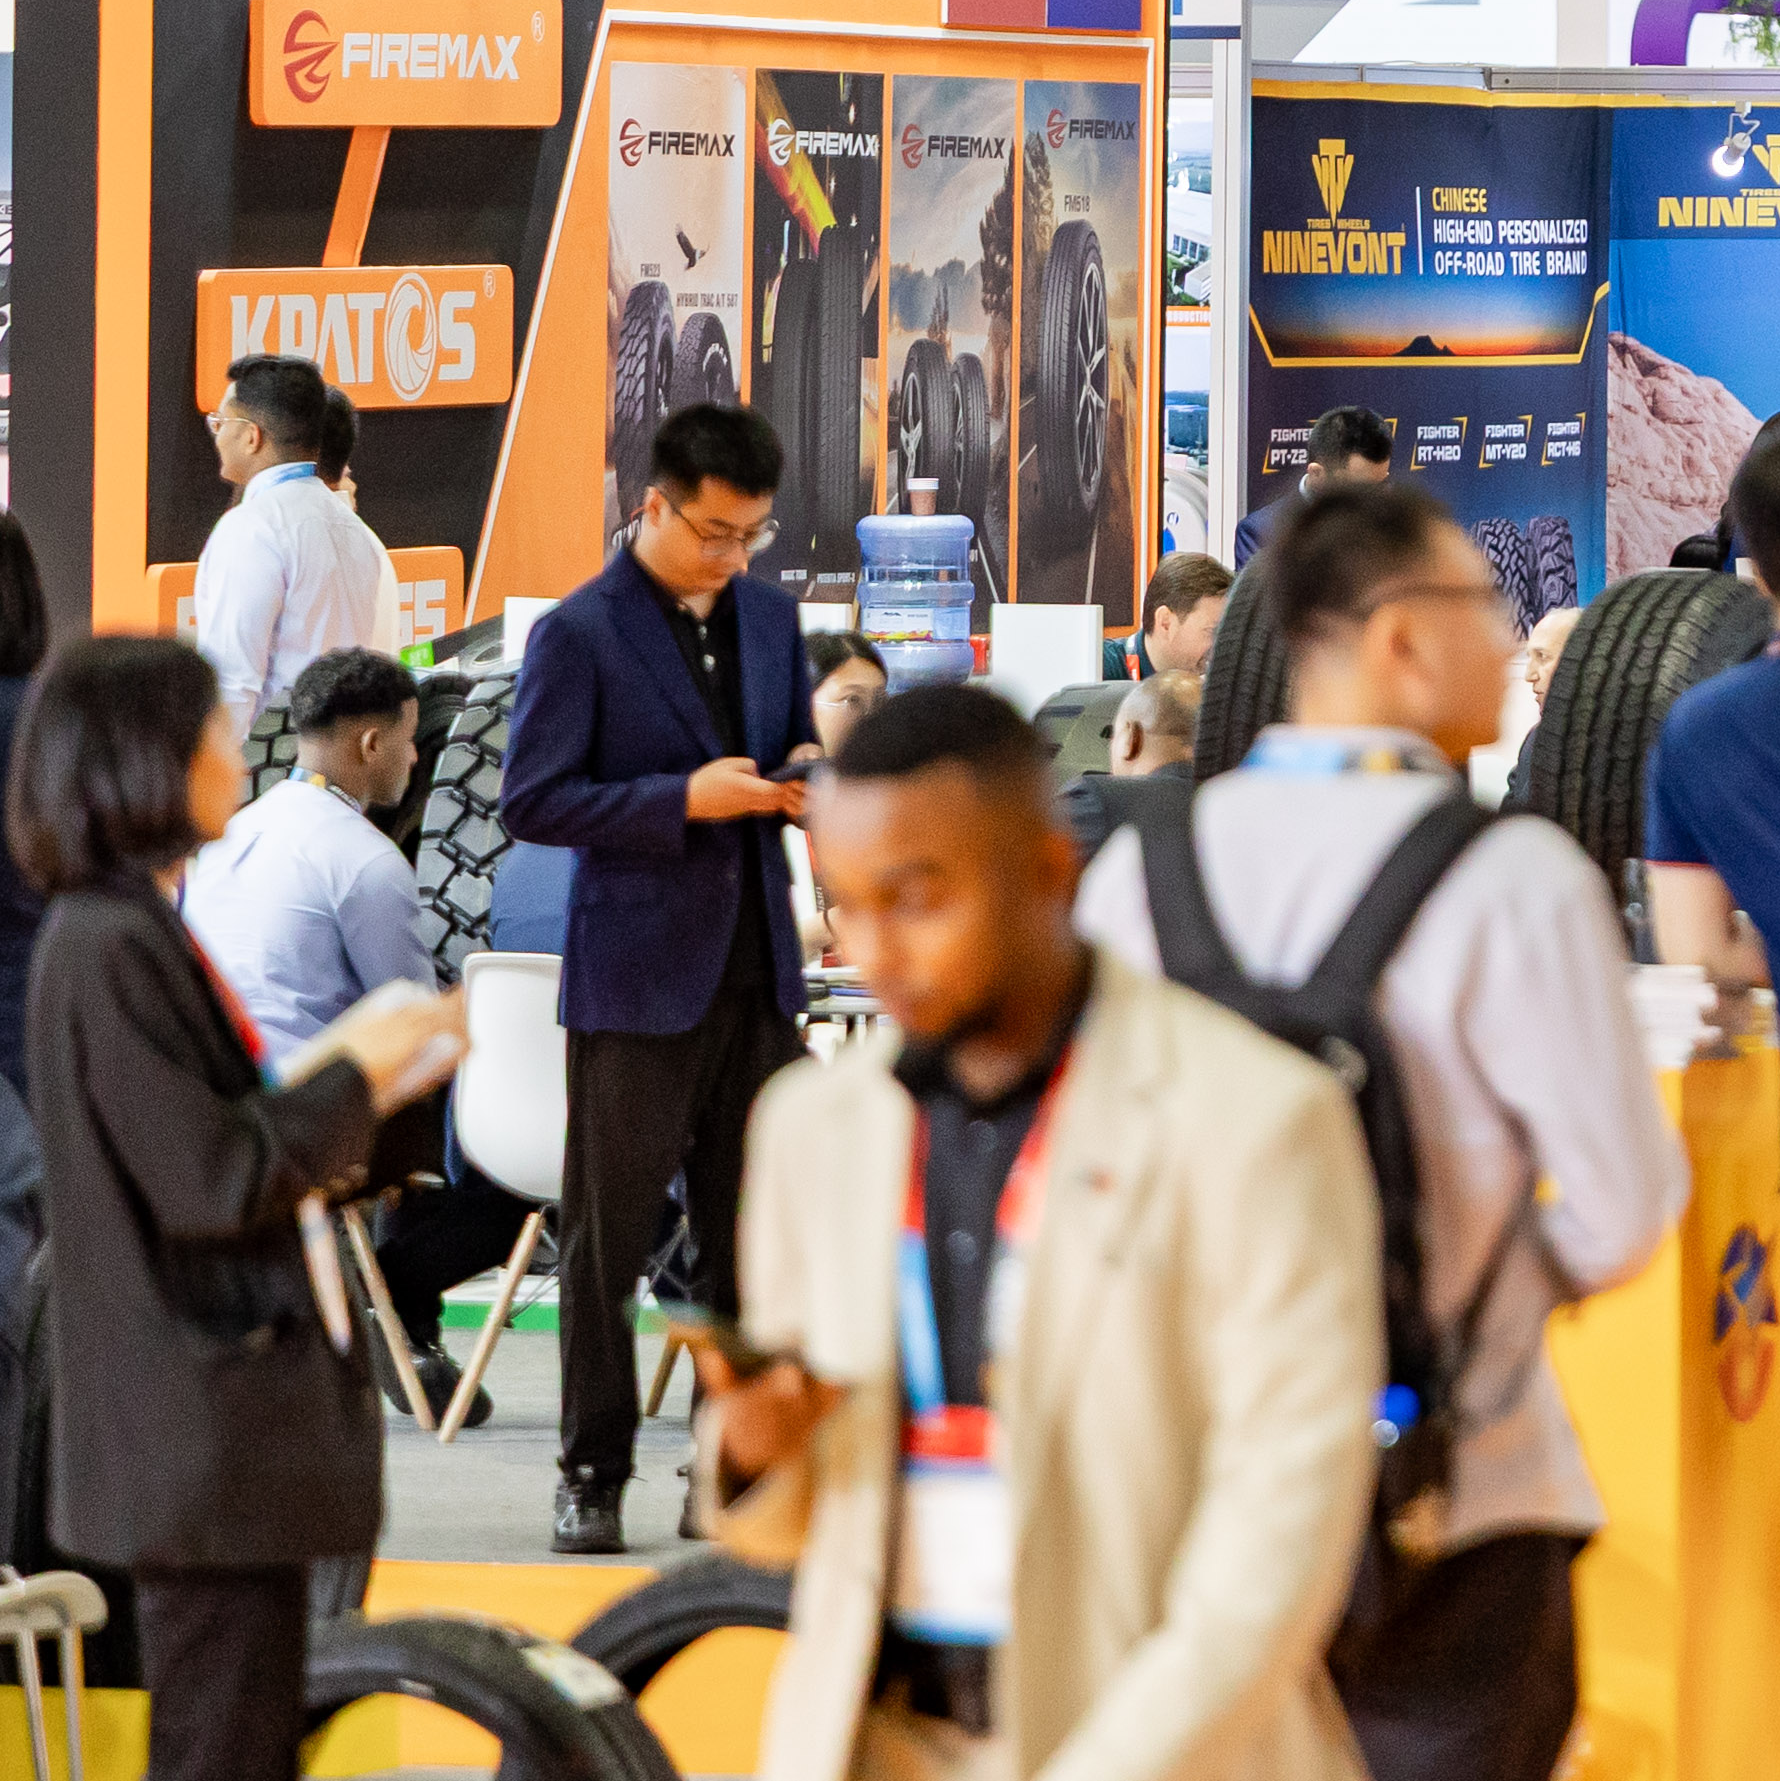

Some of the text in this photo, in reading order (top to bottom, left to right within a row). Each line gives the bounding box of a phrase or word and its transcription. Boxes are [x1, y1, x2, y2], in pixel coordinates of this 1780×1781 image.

[342, 33, 521, 80] FIREMAX
[1069, 118, 1136, 142] FIREMAX
[648, 130, 735, 158] FIREMAX
[796, 130, 877, 158] FIREMAX
[928, 134, 1005, 160] FIREMAX
[1432, 187, 1487, 213] CHINESE
[1433, 218, 1588, 245] HIGH-END PERSONALIZED
[1262, 230, 1406, 276] NINEVONT
[1434, 250, 1588, 276] OFF-ROAD TIRE BRAND
[1270, 428, 1312, 443] FIGHTE
[1417, 425, 1460, 441] FIGHTER
[1485, 423, 1525, 439] FIGHTER
[1547, 421, 1581, 436] FIGHTER
